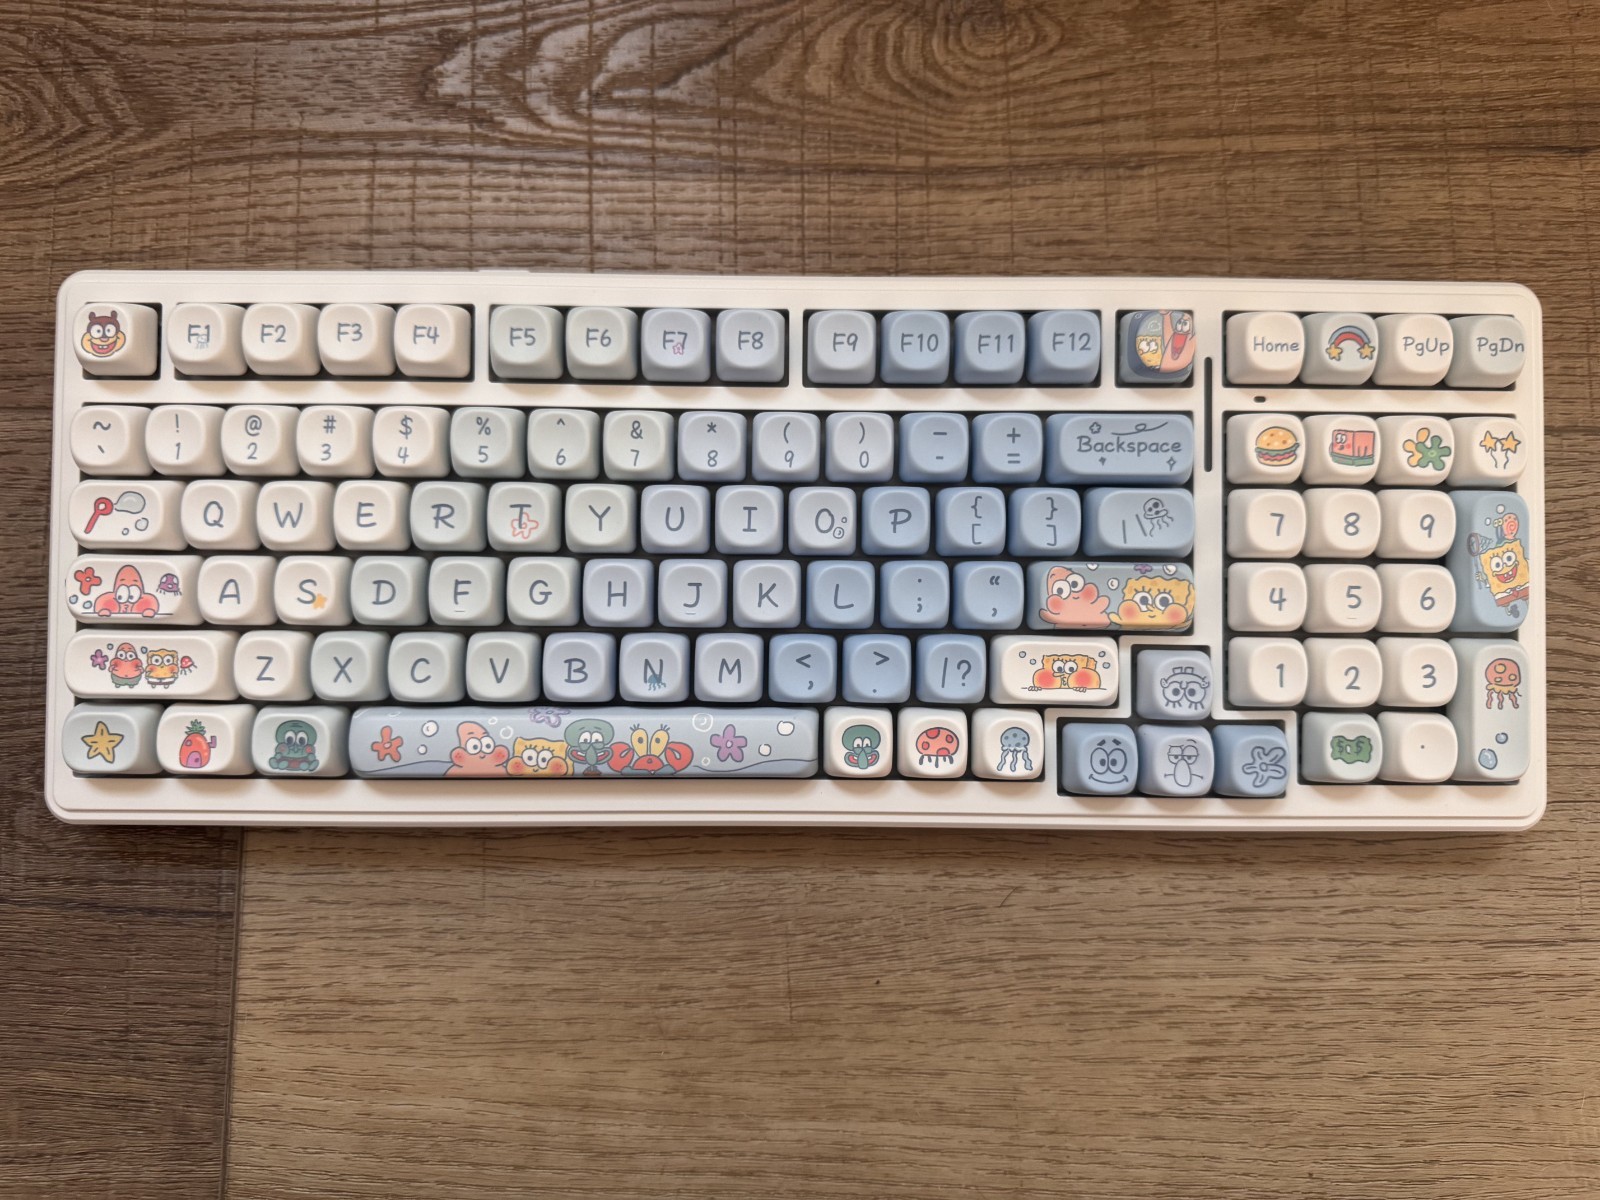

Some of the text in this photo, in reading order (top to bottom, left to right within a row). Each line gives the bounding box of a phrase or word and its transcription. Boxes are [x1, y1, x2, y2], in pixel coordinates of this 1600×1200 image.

[188, 324, 211, 343] F1
[260, 323, 287, 343] F2
[337, 321, 363, 342] F3
[412, 324, 440, 344] F4
[510, 326, 537, 348] F5
[585, 327, 612, 348] F6
[662, 329, 688, 351] F7
[738, 329, 764, 351] F8
[832, 332, 859, 353] F9
[900, 332, 939, 353] F10
[1052, 332, 1092, 352] F12
[977, 334, 1014, 354] F11
[1253, 336, 1300, 353] Home
[1403, 336, 1450, 356] PgUp
[1476, 337, 1525, 356] PgDn
[174, 413, 180, 433] !
[244, 414, 262, 437] @
[322, 414, 337, 434] #
[398, 415, 412, 439] $
[476, 416, 491, 436] %
[630, 420, 644, 440] &
[783, 421, 791, 444] (
[859, 421, 866, 445] )
[1006, 427, 1021, 444] +
[1076, 434, 1182, 457] Backspace
[174, 442, 181, 460] 1
[247, 442, 258, 460] 2
[320, 442, 332, 461] 3
[397, 445, 409, 464] 4
[478, 445, 489, 464] 5
[555, 448, 566, 466] 6
[629, 449, 640, 467] 7
[707, 449, 718, 467] 8
[784, 449, 795, 468] 9
[859, 450, 870, 469] 0
[1007, 453, 1021, 464] =
[203, 500, 224, 529] Q
[273, 501, 303, 529] W
[356, 501, 378, 528] E
[431, 502, 456, 530] R
[509, 503, 532, 530] T
[588, 504, 611, 532] Y
[970, 495, 982, 518] {
[1046, 496, 1058, 520] }
[664, 506, 685, 532] U
[742, 506, 758, 532] I
[815, 508, 835, 534] O
[888, 508, 912, 534] P
[1270, 512, 1284, 536] 7
[1343, 512, 1360, 536] 8
[1419, 514, 1435, 538] 9
[971, 523, 981, 545] [
[1046, 524, 1057, 546] ]
[218, 578, 241, 604] A
[296, 578, 318, 605] S
[371, 579, 396, 605] D
[454, 579, 472, 605] F
[528, 579, 552, 606] G
[607, 581, 628, 608] H
[682, 582, 702, 608] J
[757, 582, 779, 608] K
[834, 583, 854, 609] L
[1269, 587, 1287, 611] 4
[1347, 586, 1362, 609] 5
[1419, 587, 1435, 611] 6
[256, 656, 275, 681] Z
[332, 656, 353, 683] X
[795, 654, 811, 669] <
[873, 651, 890, 666] >
[410, 658, 432, 684] C
[489, 658, 509, 684] V
[563, 658, 588, 684] B
[643, 658, 664, 684] N
[718, 658, 742, 684] M
[1276, 663, 1284, 688] 1
[1343, 666, 1360, 690] 2
[1420, 664, 1436, 688] 3
